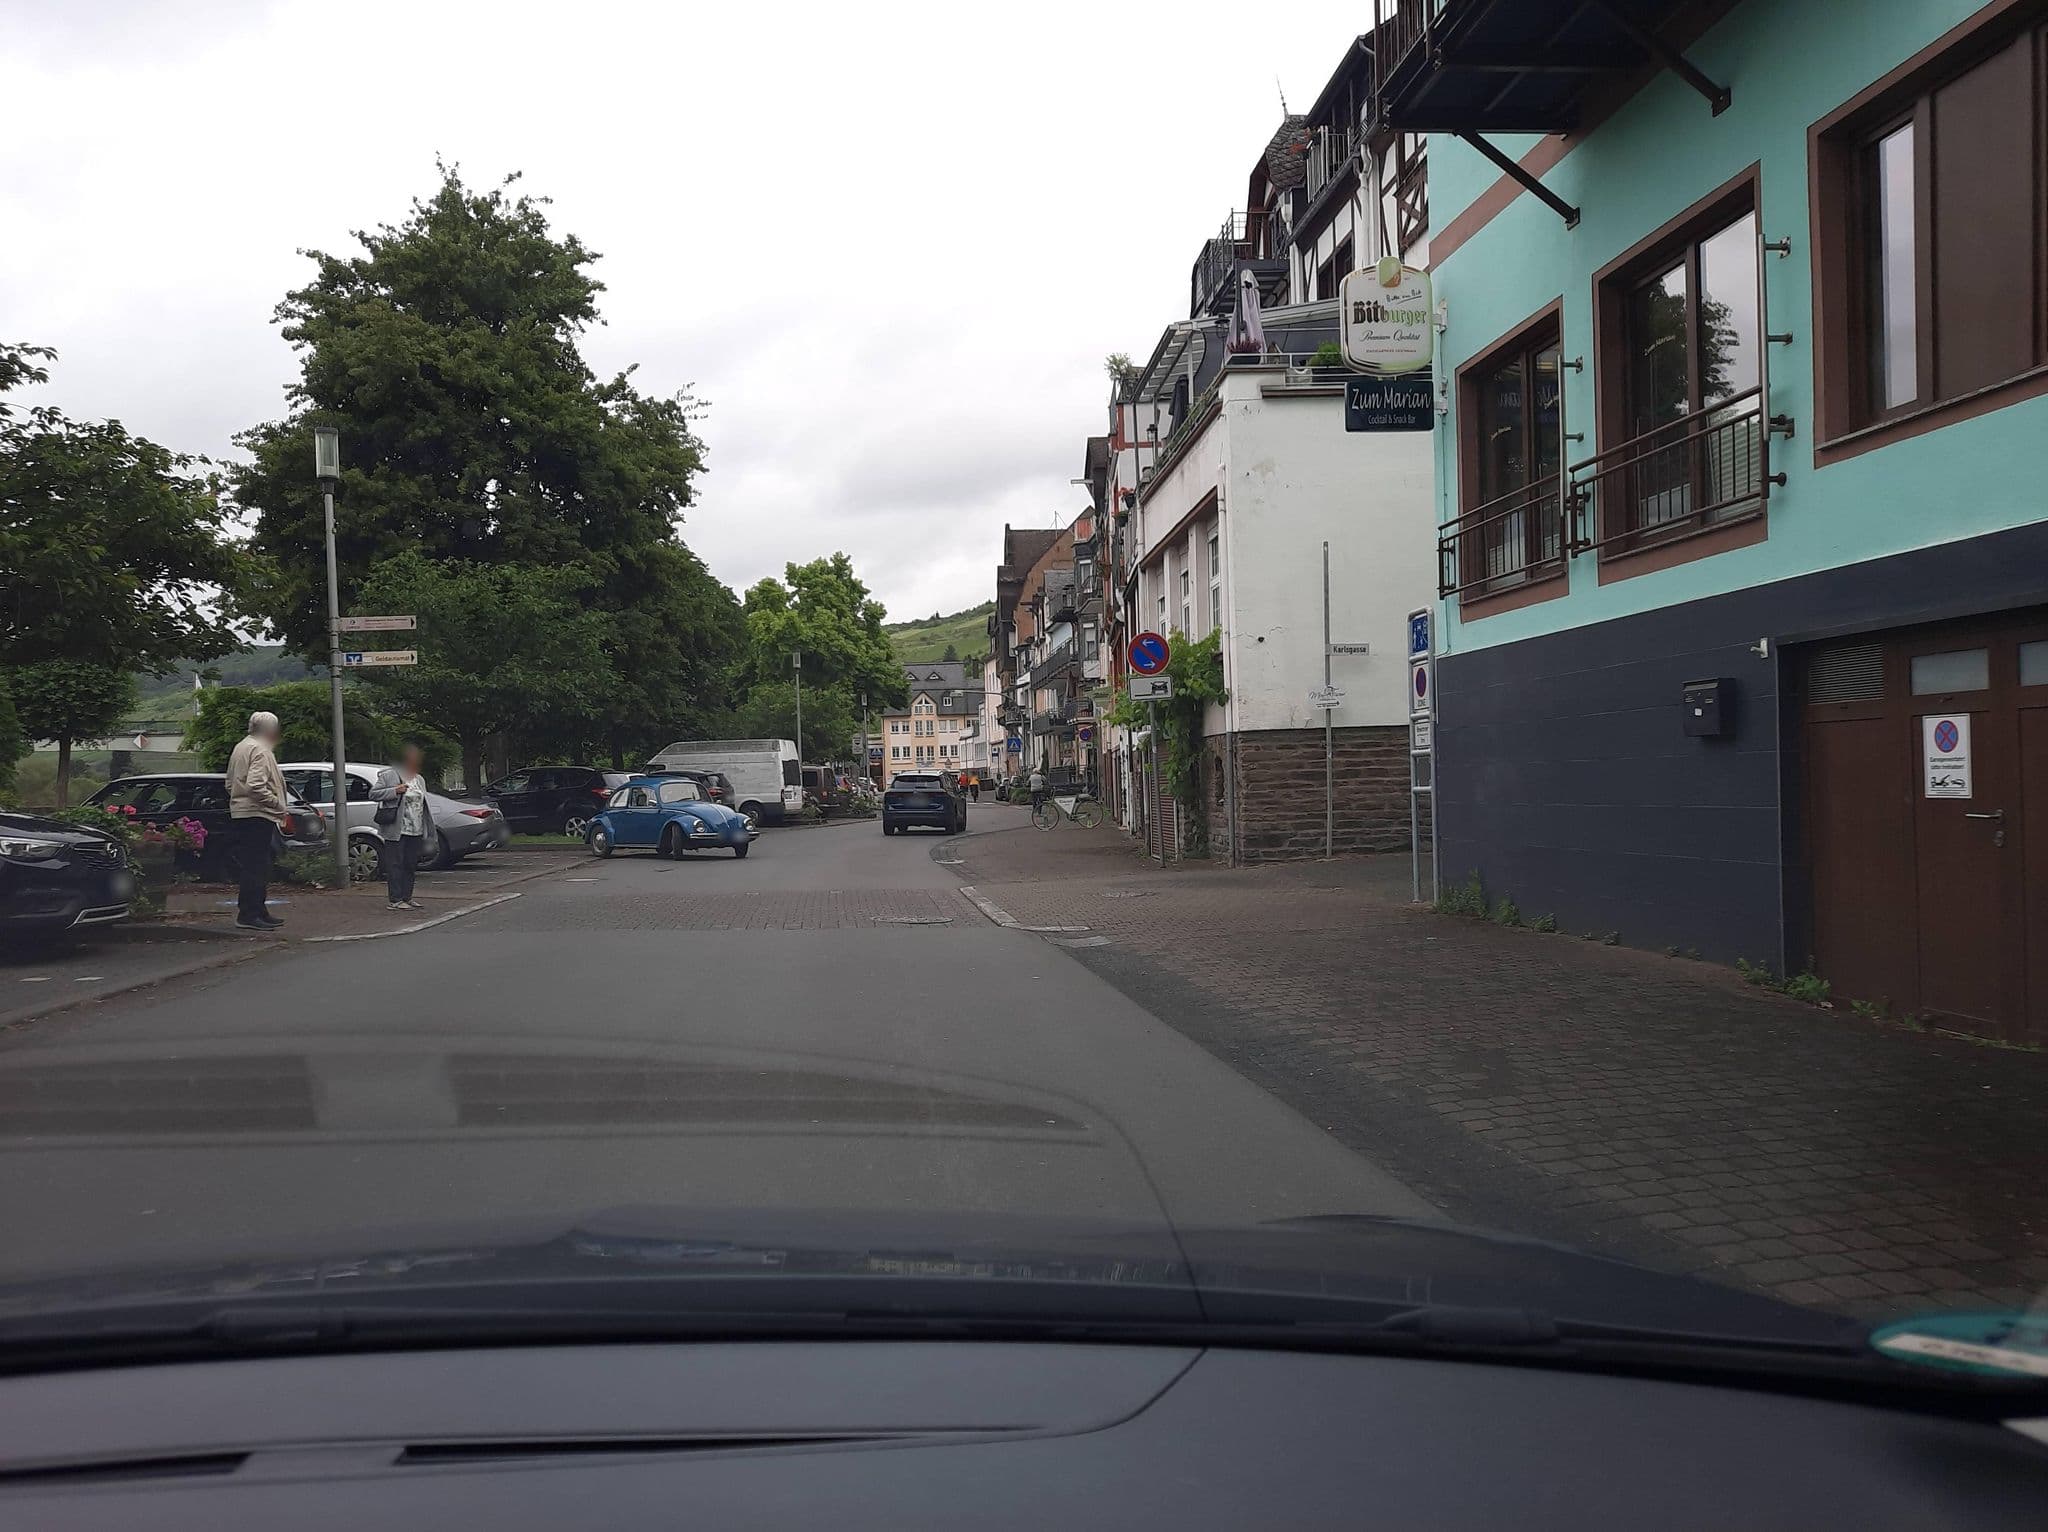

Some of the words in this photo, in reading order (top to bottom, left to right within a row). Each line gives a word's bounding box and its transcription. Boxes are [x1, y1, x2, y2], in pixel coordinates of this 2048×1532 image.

[1353, 300, 1426, 326] Bitburger
[1352, 388, 1382, 410] Zum
[1384, 386, 1431, 410] Marian
[1367, 413, 1387, 424] Cocktail
[1393, 413, 1407, 424] Snack
[1407, 414, 1416, 424] Bar
[1333, 646, 1366, 655] Karlsgasse
